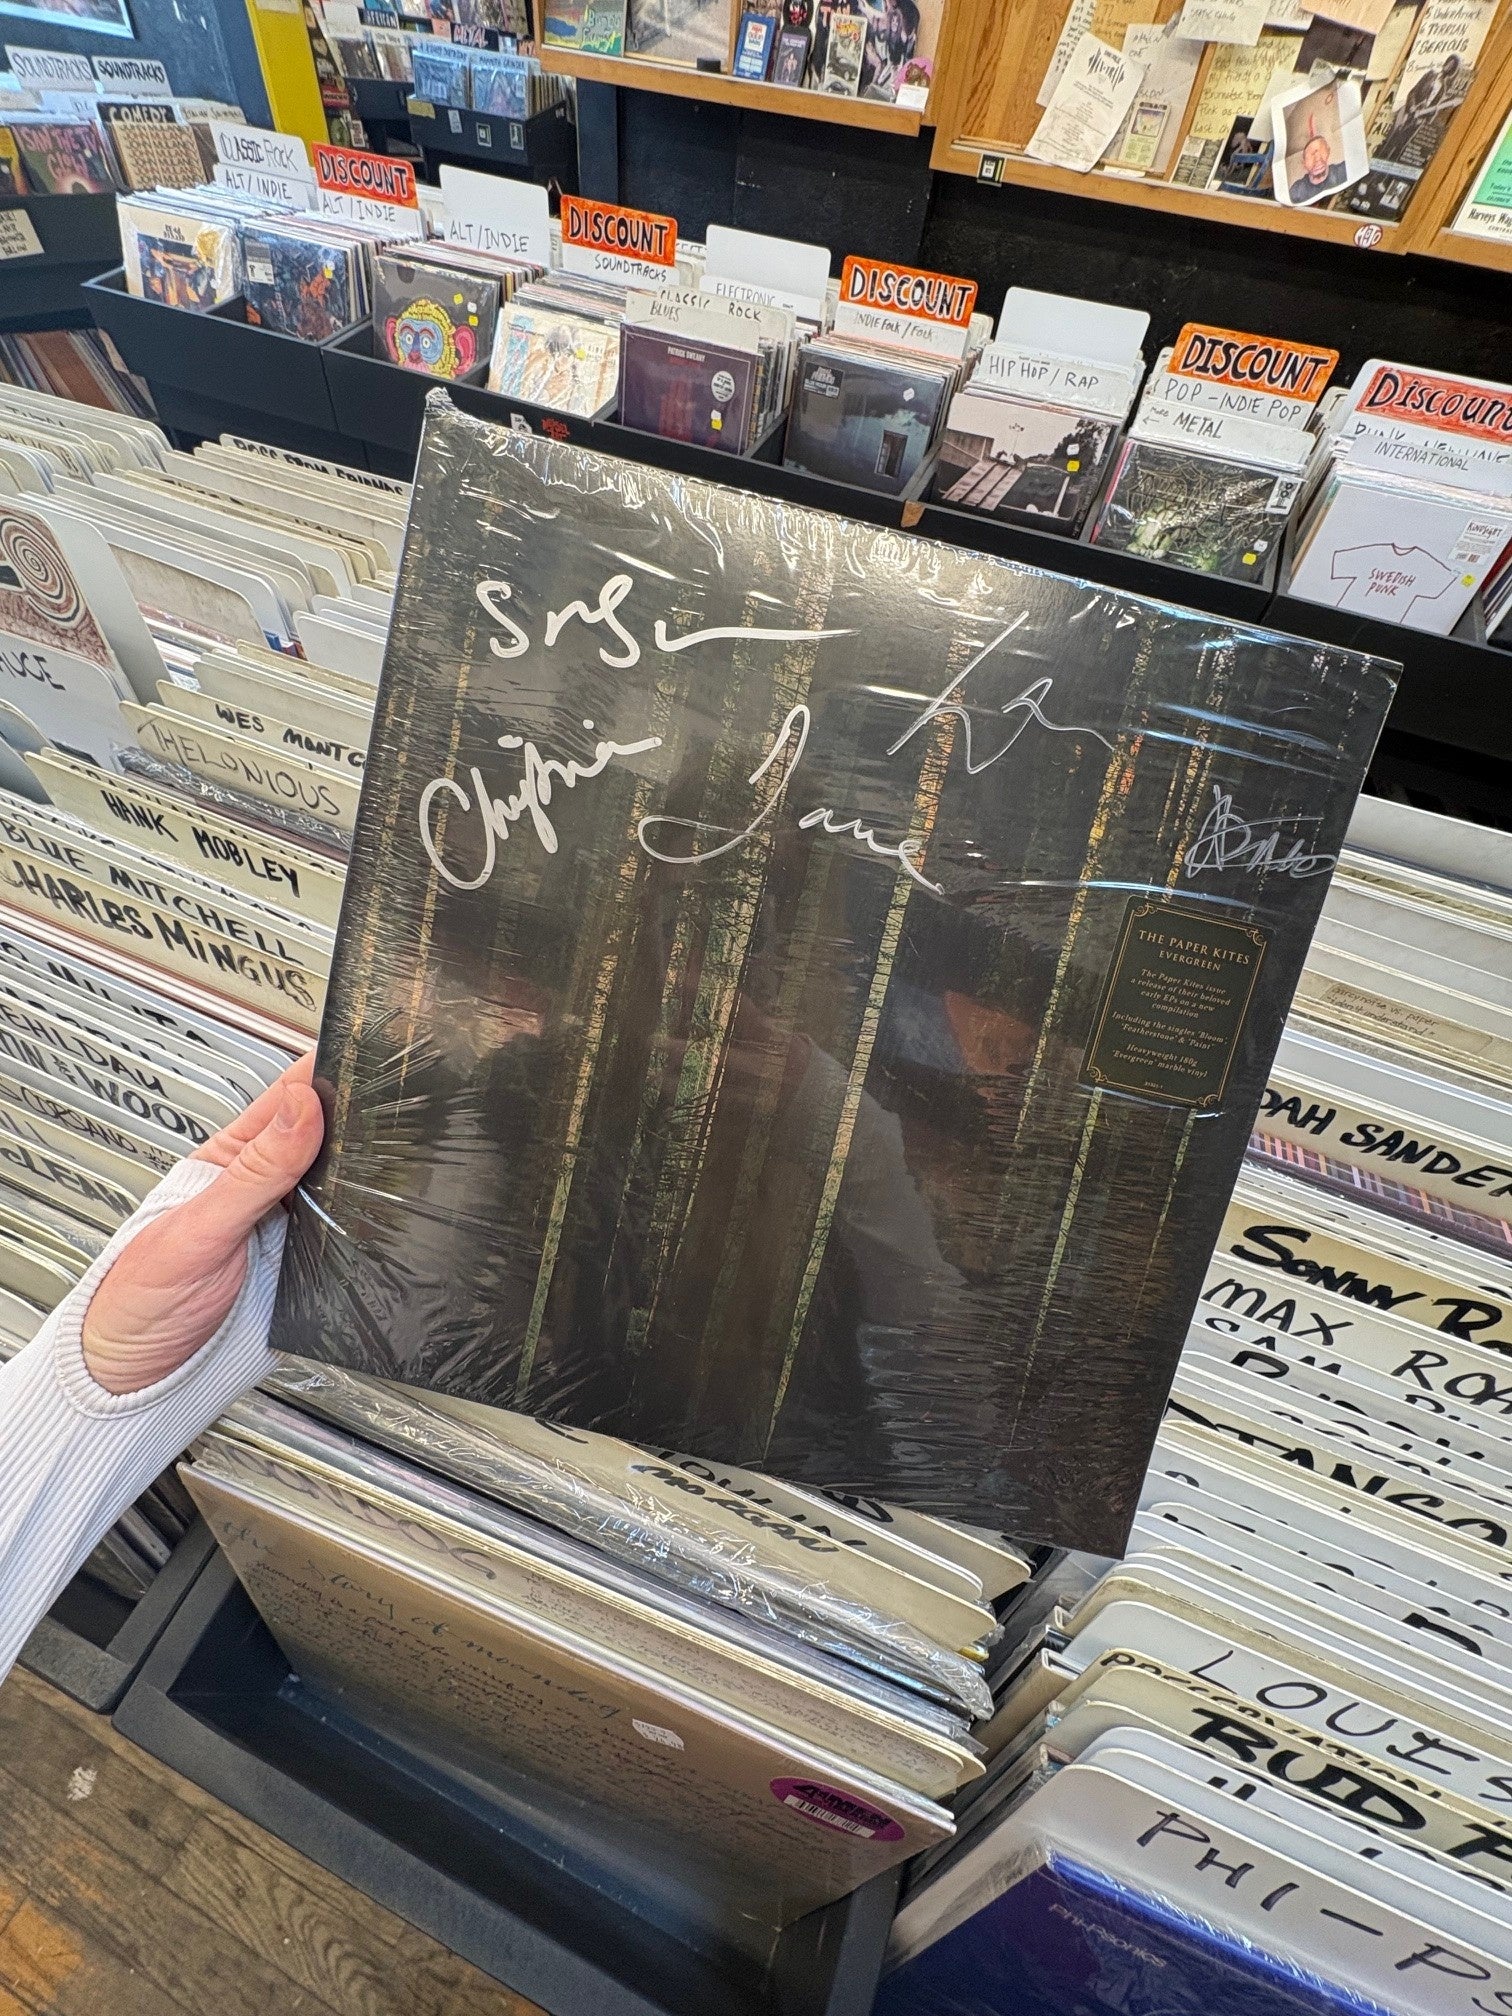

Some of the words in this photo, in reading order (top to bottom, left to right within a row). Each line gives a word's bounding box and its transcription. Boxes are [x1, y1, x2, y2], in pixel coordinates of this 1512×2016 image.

[12, 53, 92, 79] SOUNDTRACKS
[99, 60, 165, 83] SOUNDTRACKS
[109, 105, 168, 123] COMEDY
[320, 152, 408, 196] DISCOUNT
[569, 206, 669, 257] DISCOUNT
[595, 254, 667, 282] SOUNDTRACKS
[850, 265, 974, 321] DISCOUNT
[650, 301, 682, 322] BLUES
[729, 302, 761, 323] ROCK
[990, 355, 1016, 378] HIP
[1021, 358, 1048, 380] HOP
[1065, 371, 1099, 391] RAP
[1180, 333, 1330, 393] DISCOUNT
[1165, 378, 1203, 401] POP
[1270, 400, 1302, 421] POP
[1173, 412, 1223, 439] METAL
[1375, 441, 1469, 471] INTERNATIONAL
[1365, 582, 1399, 597] PUNK
[1369, 568, 1416, 586] SWEDISH
[216, 704, 264, 733] WES
[137, 719, 340, 816] THELONIOUS
[100, 790, 179, 843] HANK
[191, 826, 300, 898] MOBLEY
[1, 819, 94, 875] BLUE
[109, 866, 305, 966] MITCHELL
[1139, 930, 1164, 944] THE
[1169, 937, 1208, 955] PAPER
[1213, 948, 1250, 965] KITES
[1159, 951, 1221, 971] EVERGREEN
[1137, 978, 1167, 991] release
[1168, 985, 1178, 995] of
[1178, 988, 1198, 1000] their
[1200, 992, 1231, 1006] beloved
[1141, 969, 1157, 979] The
[1158, 973, 1181, 985] Paper
[1184, 978, 1204, 990] Kites
[1206, 984, 1226, 995] issue
[1140, 990, 1162, 1001] early
[1163, 993, 1179, 1005] EPs
[1199, 1004, 1216, 1012] new
[1151, 1002, 1199, 1019] compilation
[1112, 1011, 1151, 1029] Including
[1152, 1019, 1167, 1030] the
[1168, 1023, 1195, 1037] singles
[0, 1004, 169, 1098] EHLDAU
[1127, 1043, 1178, 1062] Heavyweight
[1179, 1055, 1199, 1068] 180g
[1157, 1061, 1186, 1074] marble
[1187, 1067, 1208, 1080] vinyl
[73, 1063, 210, 1144] WOOD
[1201, 1279, 1354, 1346] MAX
[631, 1463, 839, 1553] MORGAN
[1188, 1706, 1426, 1831] BUD
